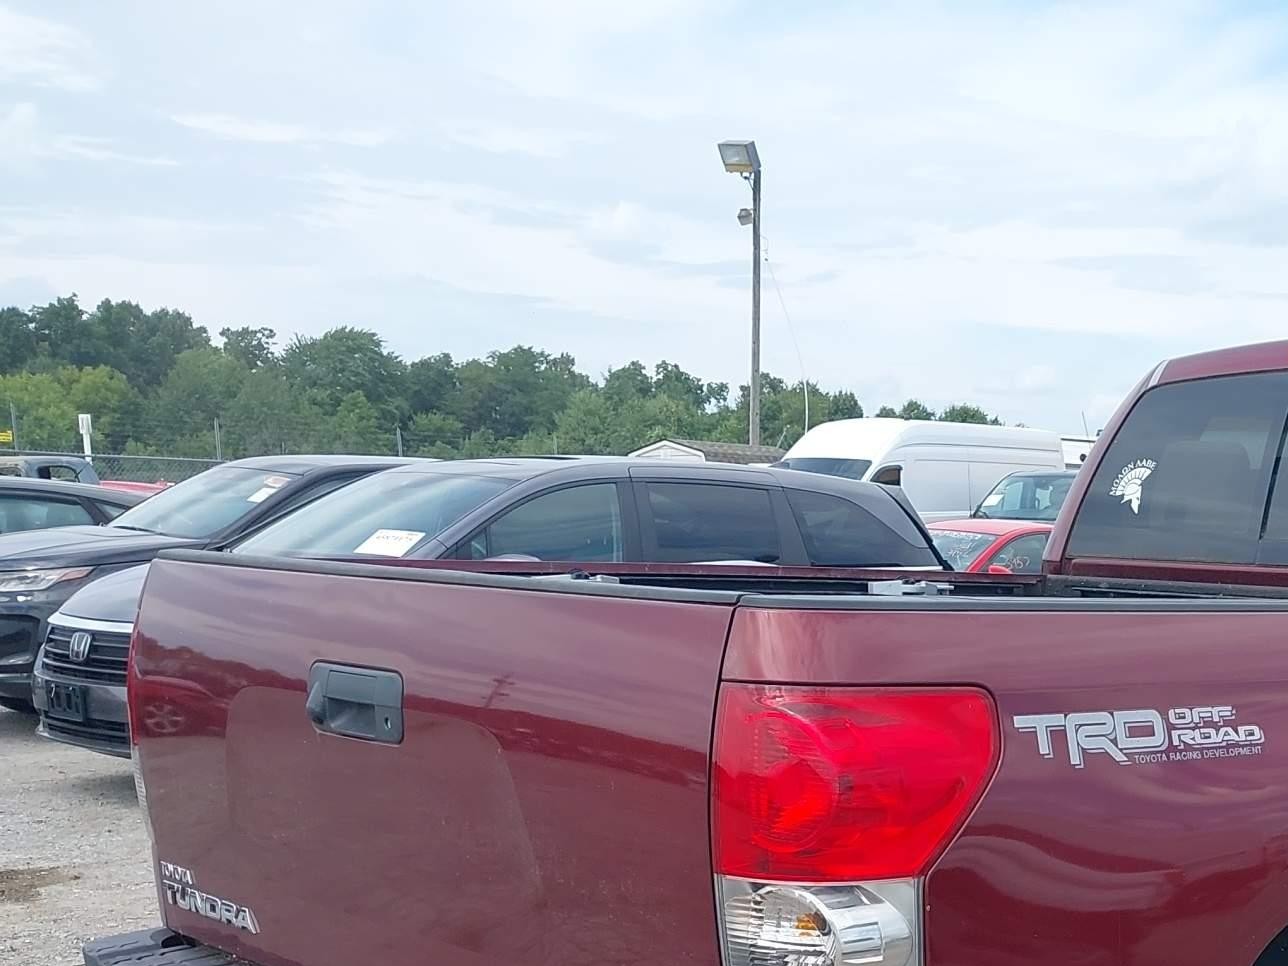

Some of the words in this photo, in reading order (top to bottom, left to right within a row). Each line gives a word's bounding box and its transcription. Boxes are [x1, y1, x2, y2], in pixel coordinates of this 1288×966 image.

[1168, 706, 1236, 726] OFF
[1013, 709, 1168, 768] TRD
[1171, 725, 1264, 749] ROAD
[1134, 753, 1167, 764] TOYOTA
[1169, 750, 1201, 761] RACING
[1203, 745, 1263, 759] DEVELOPMENT
[160, 860, 195, 885] TOYOTA
[162, 879, 259, 934] TUNDRA
